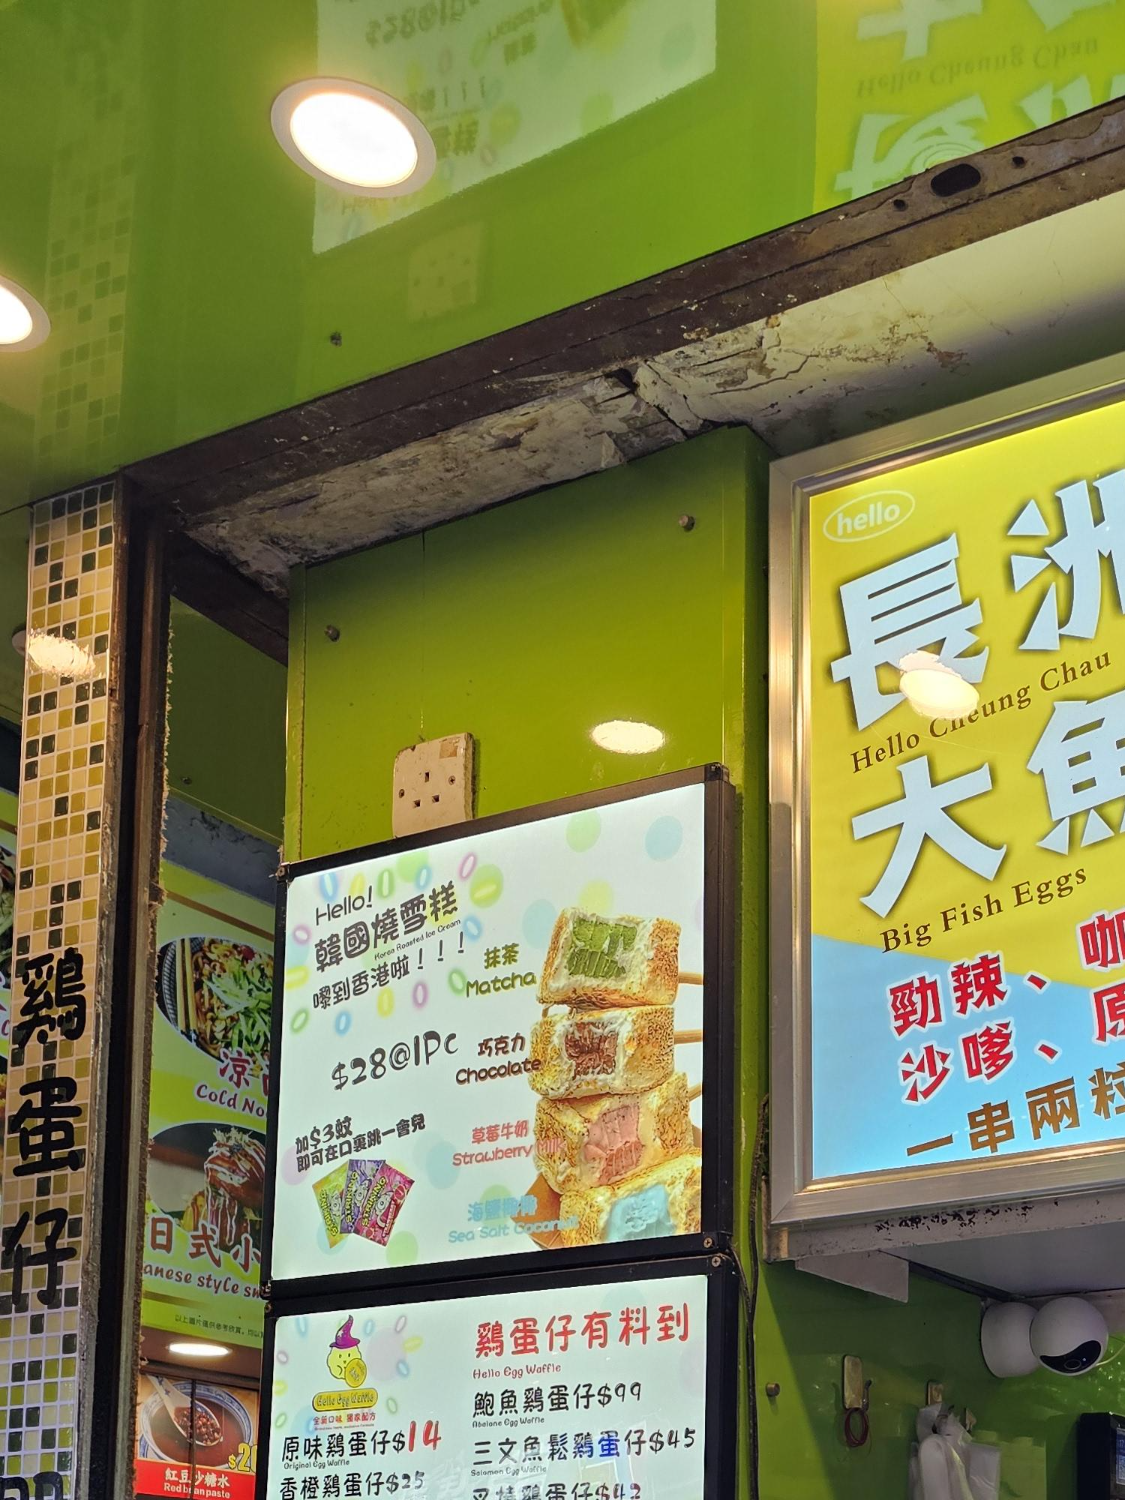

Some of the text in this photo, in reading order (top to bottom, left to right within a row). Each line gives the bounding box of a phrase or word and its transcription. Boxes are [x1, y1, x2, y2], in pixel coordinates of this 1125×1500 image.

[836, 499, 902, 538] hello
[850, 650, 1112, 774] Hello Cheung Chau
[315, 885, 373, 926] Hello!
[880, 865, 1088, 955] Big Fish Eggs
[315, 881, 458, 972] 韓國燒雪糕
[437, 919, 461, 933] Cream
[484, 943, 520, 969] 抹茶
[466, 972, 537, 998] Matcha
[477, 1032, 526, 1057] 巧克力
[455, 1058, 541, 1085] Chocolate
[196, 1084, 238, 1110] Cold
[471, 1120, 529, 1145] 草莓牛奶
[452, 1144, 533, 1166] Strawberry
[448, 1230, 475, 1244] Sea
[479, 1224, 510, 1239] Salt
[144, 1264, 192, 1284] anese
[197, 1274, 239, 1294] style
[472, 1363, 561, 1380] Hello Egg Waffle
[163, 1482, 182, 1492] Red
[205, 1489, 231, 1499] paste
